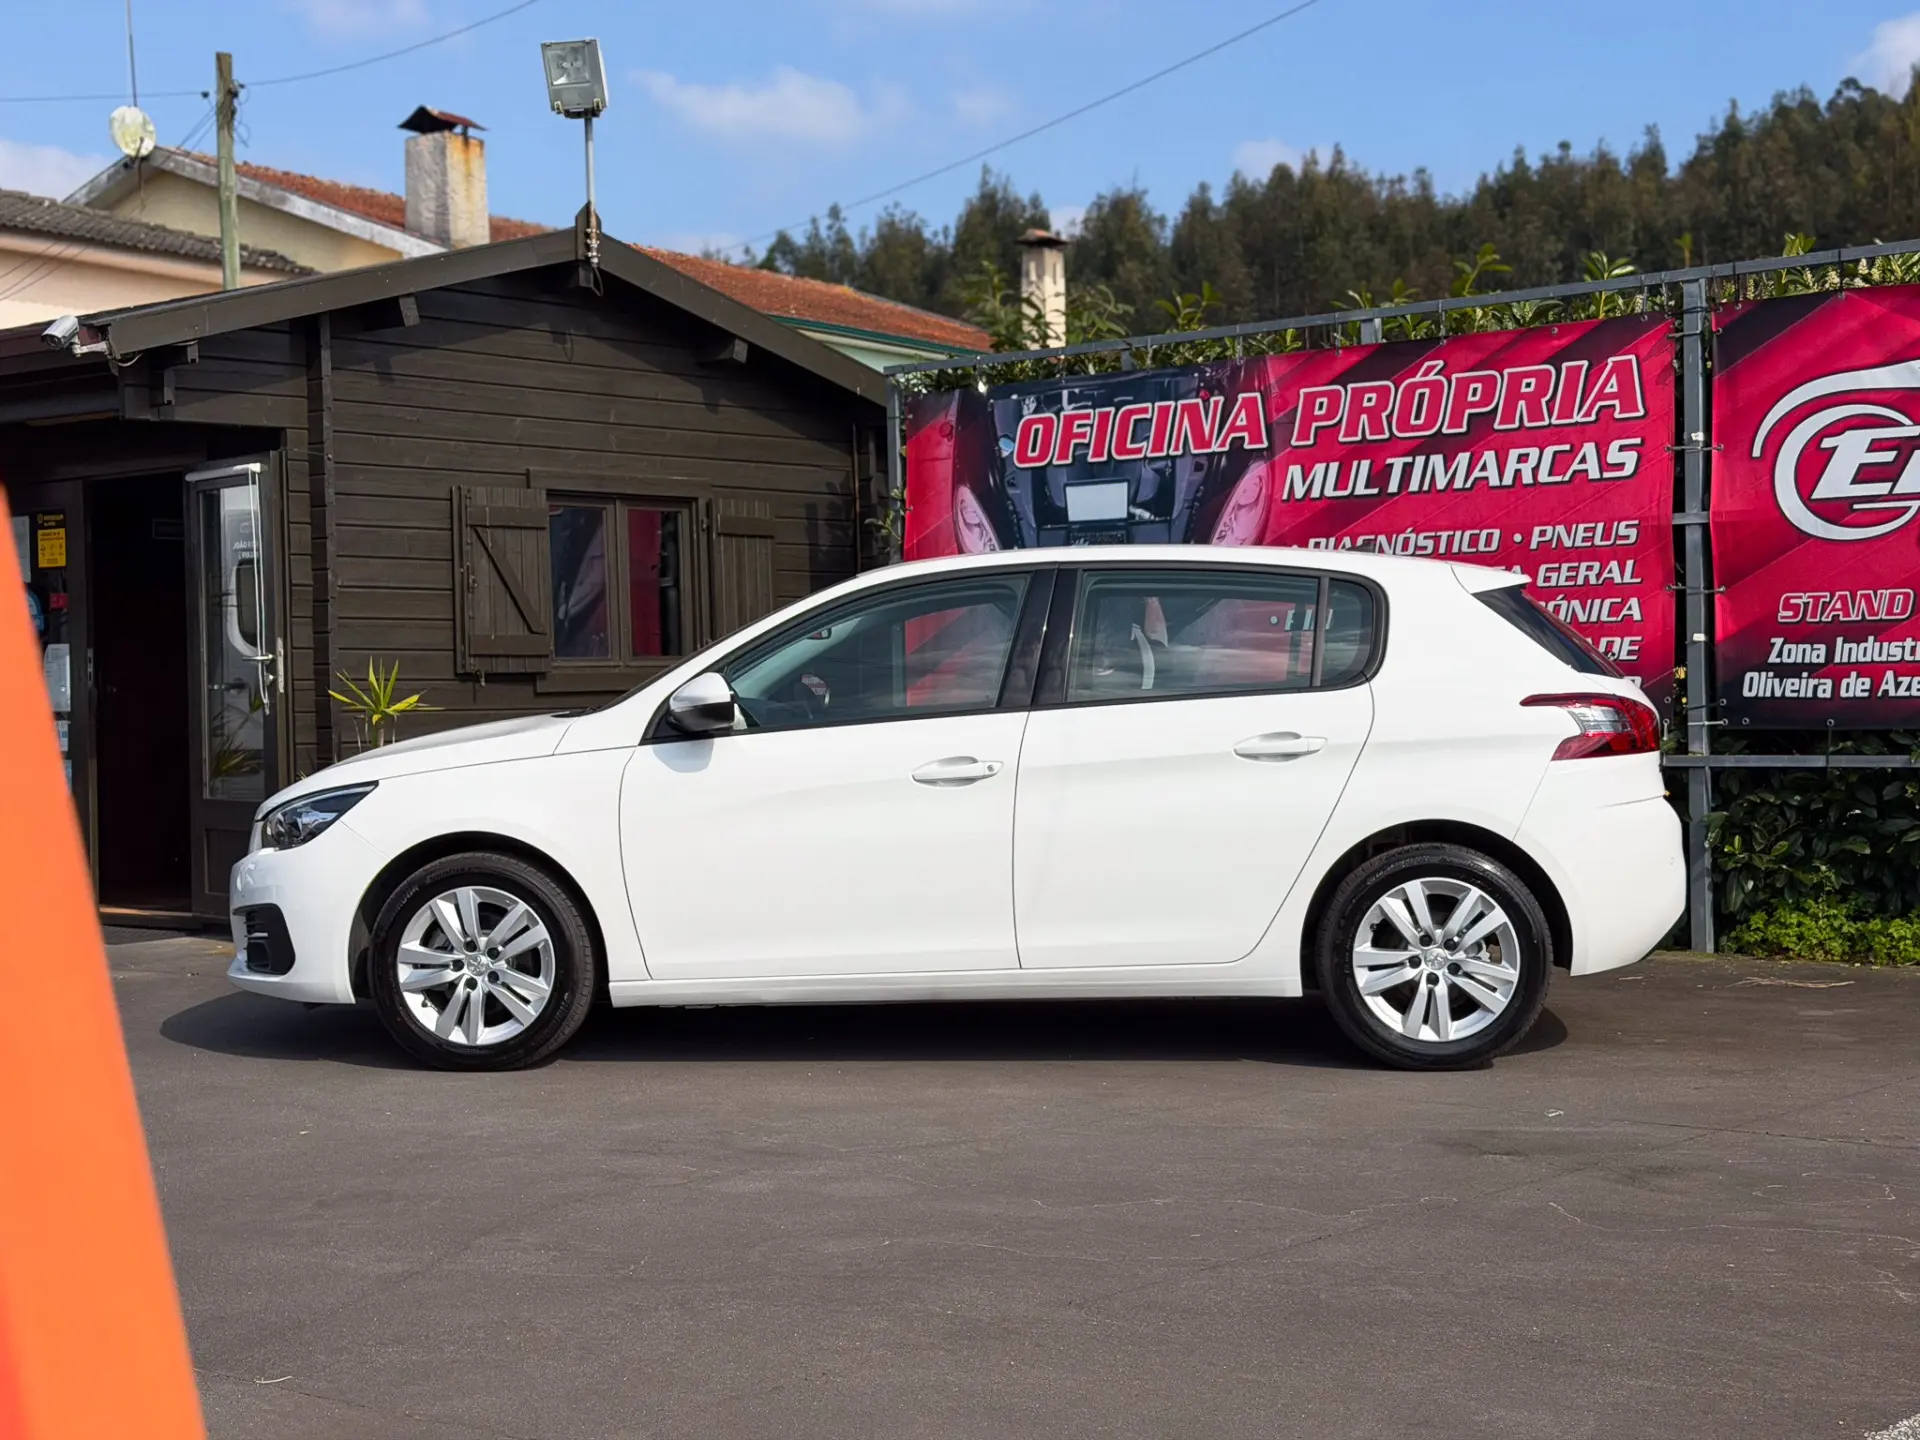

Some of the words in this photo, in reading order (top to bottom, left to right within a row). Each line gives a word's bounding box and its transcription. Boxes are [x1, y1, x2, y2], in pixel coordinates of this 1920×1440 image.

[1013, 392, 1268, 468] OFICINA
[1290, 354, 1645, 446] PRÓPRIA
[1282, 437, 1643, 500] MULTIMARCAS
[1529, 520, 1639, 550] PNEUS
[1536, 559, 1642, 587] GERAL
[1538, 594, 1642, 623] ÓNICA
[1778, 588, 1914, 622] STAND
[1767, 637, 1827, 663] Zona
[1742, 671, 1833, 698] Oliveira
[1840, 671, 1871, 698] de
